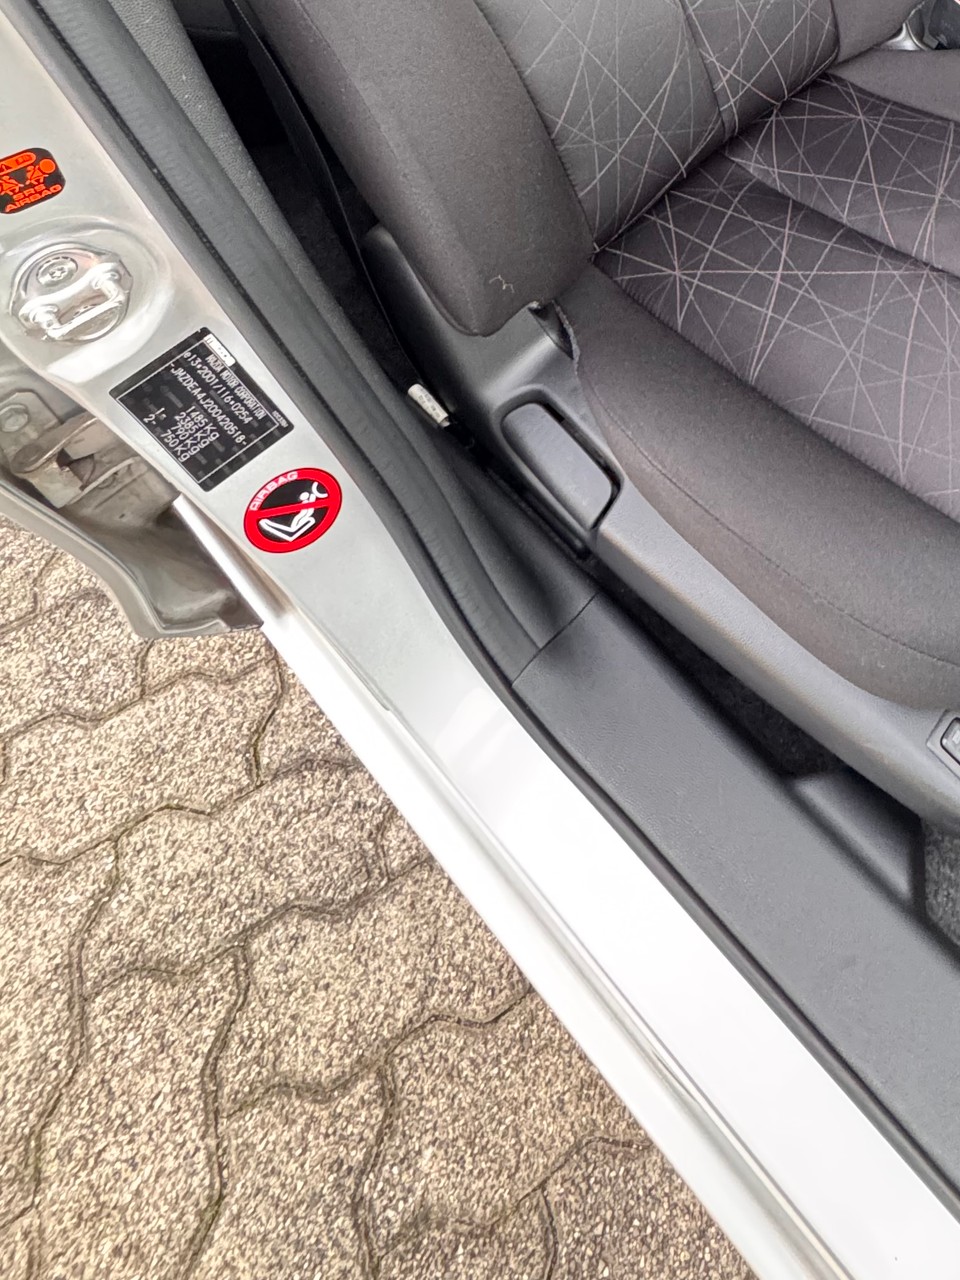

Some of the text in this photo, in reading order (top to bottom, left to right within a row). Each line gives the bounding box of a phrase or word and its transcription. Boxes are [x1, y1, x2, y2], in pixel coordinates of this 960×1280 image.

[5, 184, 62, 212] AIRBAG
[13, 183, 46, 201] SRS
[206, 353, 267, 420] MAZDA MOTOR CORPORATION
[249, 471, 298, 511] AIRBAG
